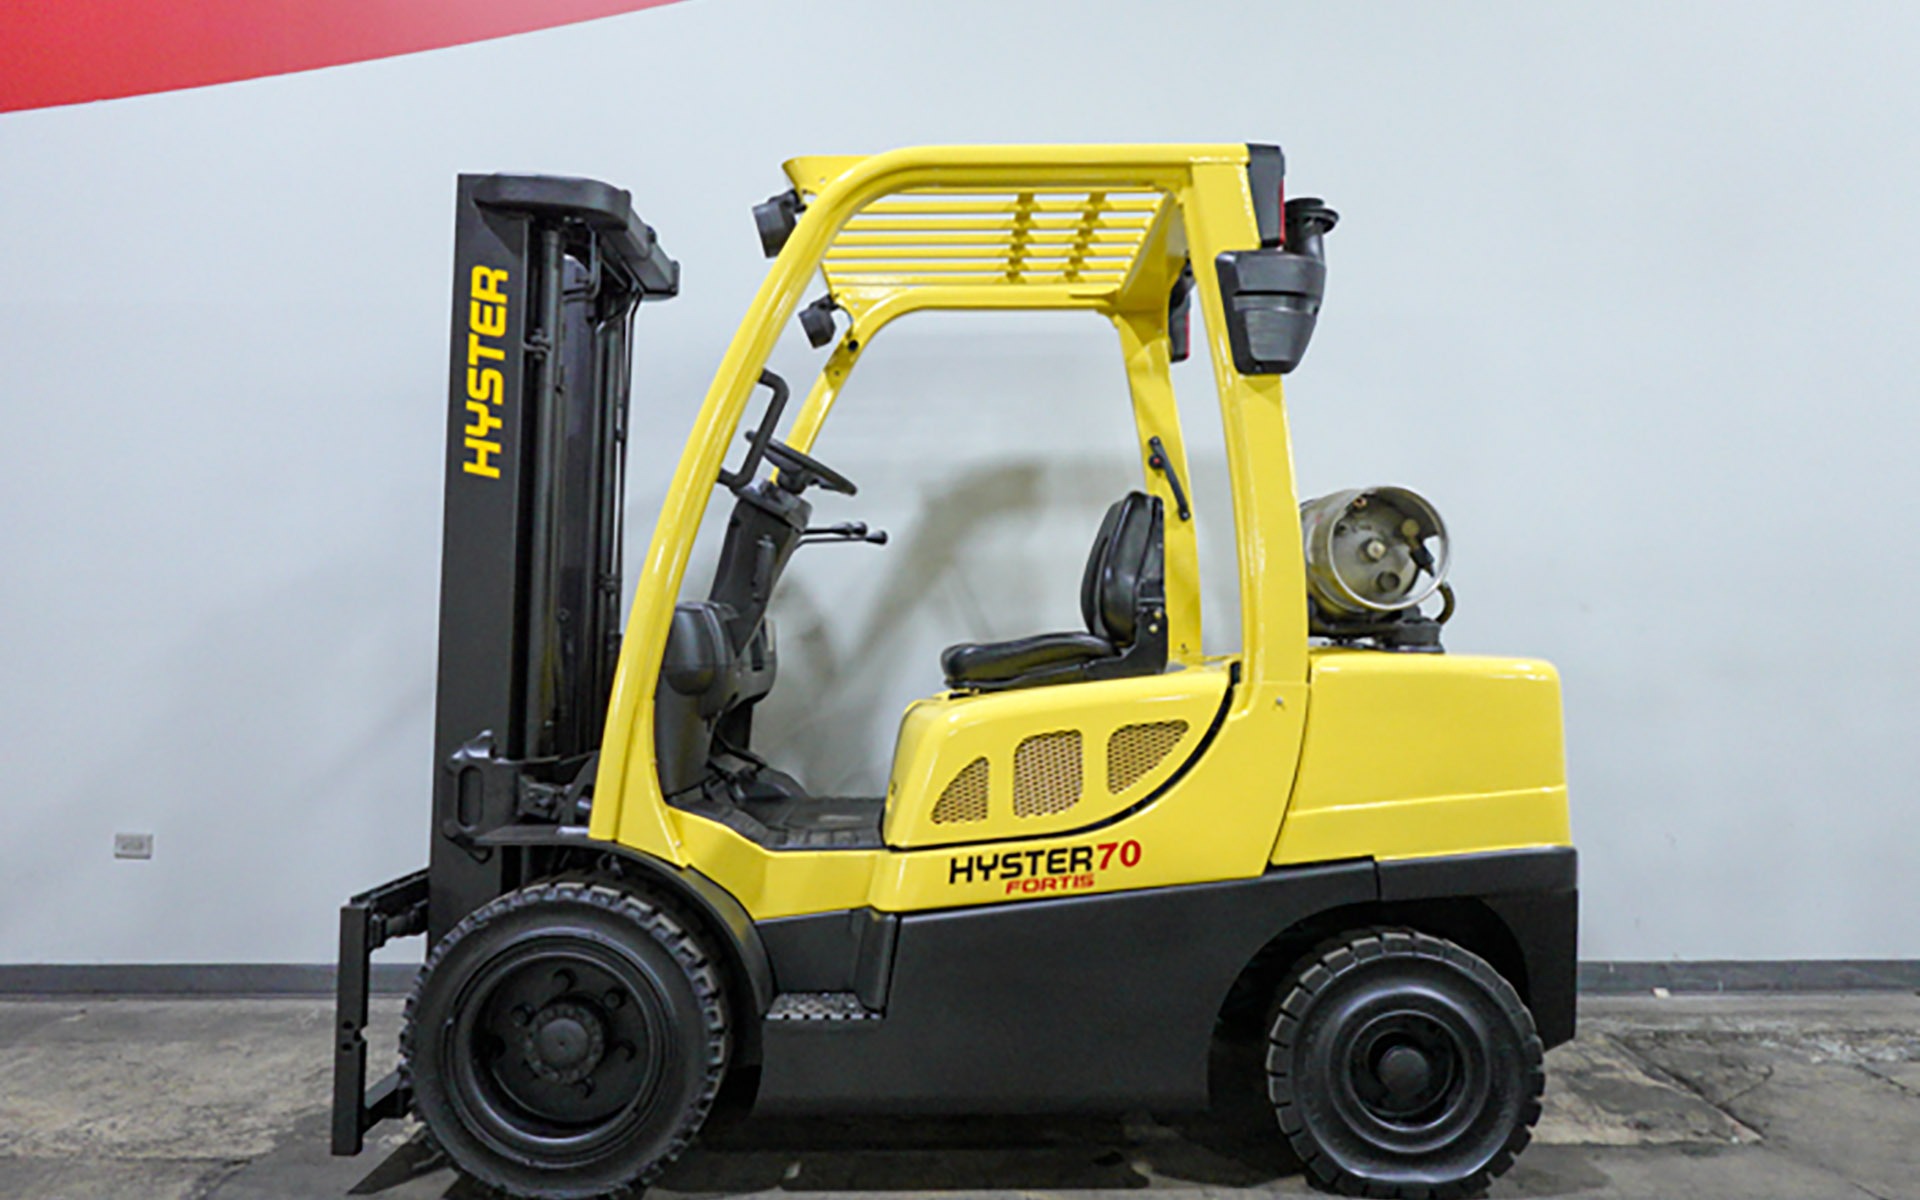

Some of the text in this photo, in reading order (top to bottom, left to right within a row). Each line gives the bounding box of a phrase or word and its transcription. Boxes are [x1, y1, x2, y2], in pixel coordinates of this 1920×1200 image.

[463, 265, 508, 479] HYSTER
[949, 839, 1142, 884] HYSTER 70
[1005, 873, 1095, 895] FORTIS
